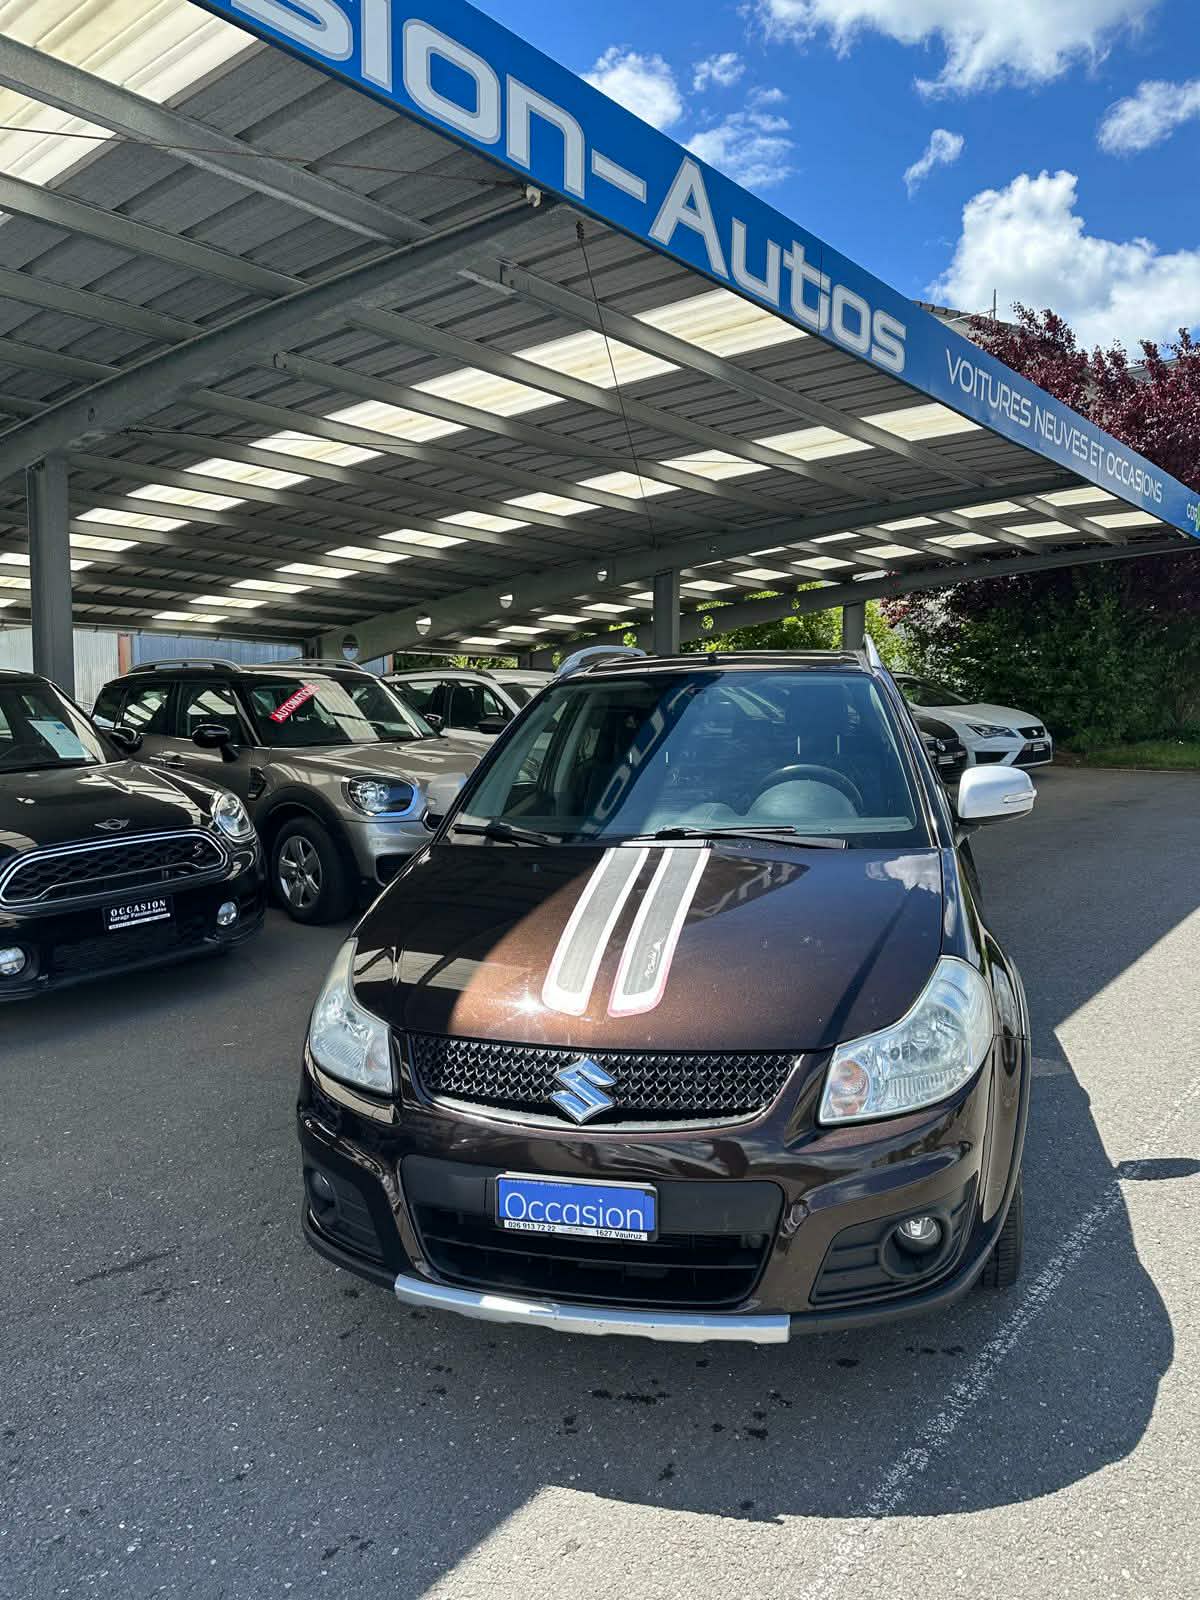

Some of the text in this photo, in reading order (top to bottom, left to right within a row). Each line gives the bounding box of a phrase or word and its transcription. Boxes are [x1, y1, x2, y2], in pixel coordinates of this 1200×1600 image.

[946, 347, 1163, 503] VOITURES NEUVES ET OCCASIONS
[110, 899, 166, 917] OCCASION
[505, 1192, 643, 1231] Occasion
[508, 1221, 520, 1229] 026
[596, 1229, 613, 1237] 1627
